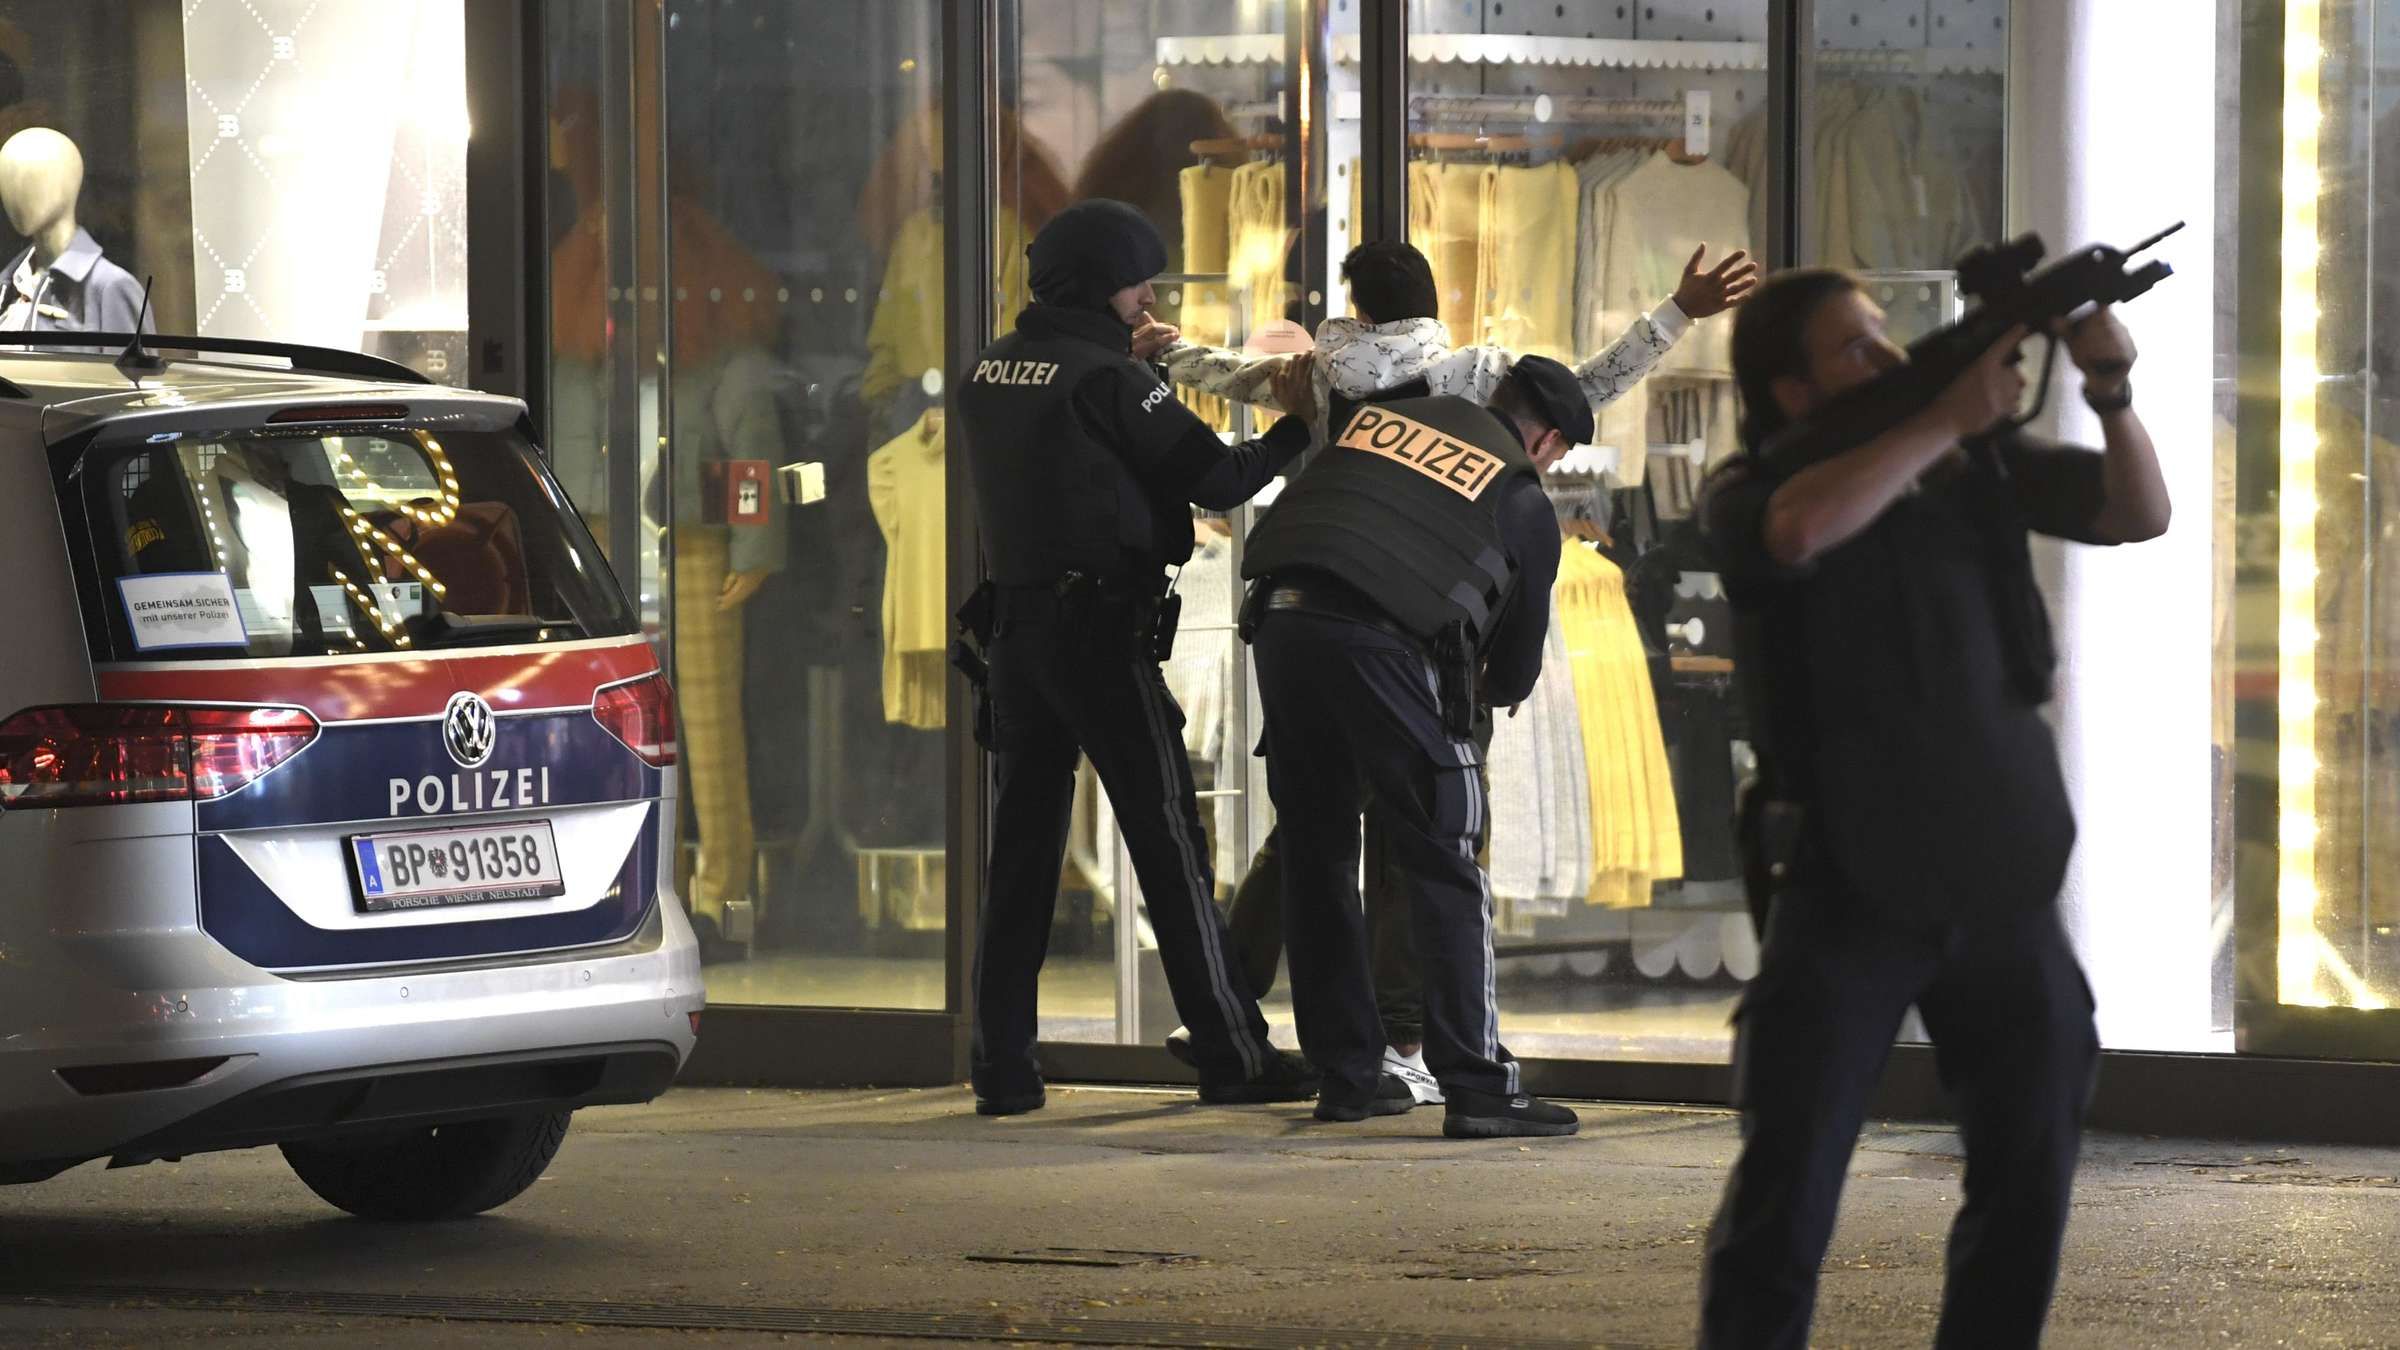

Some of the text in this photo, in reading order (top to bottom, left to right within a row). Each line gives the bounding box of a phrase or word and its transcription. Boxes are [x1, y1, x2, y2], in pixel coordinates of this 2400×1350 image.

[972, 359, 1059, 385] POLIZEI
[1140, 381, 1171, 413] POLI
[1344, 410, 1496, 493] POLIZEI
[143, 610, 229, 623] mit unserer Polizei
[389, 766, 549, 816] POLIZEI
[387, 834, 541, 887] BP 91358
[369, 879, 378, 888] A
[391, 887, 542, 909] PORSCHE WIENER NEUSTADT
